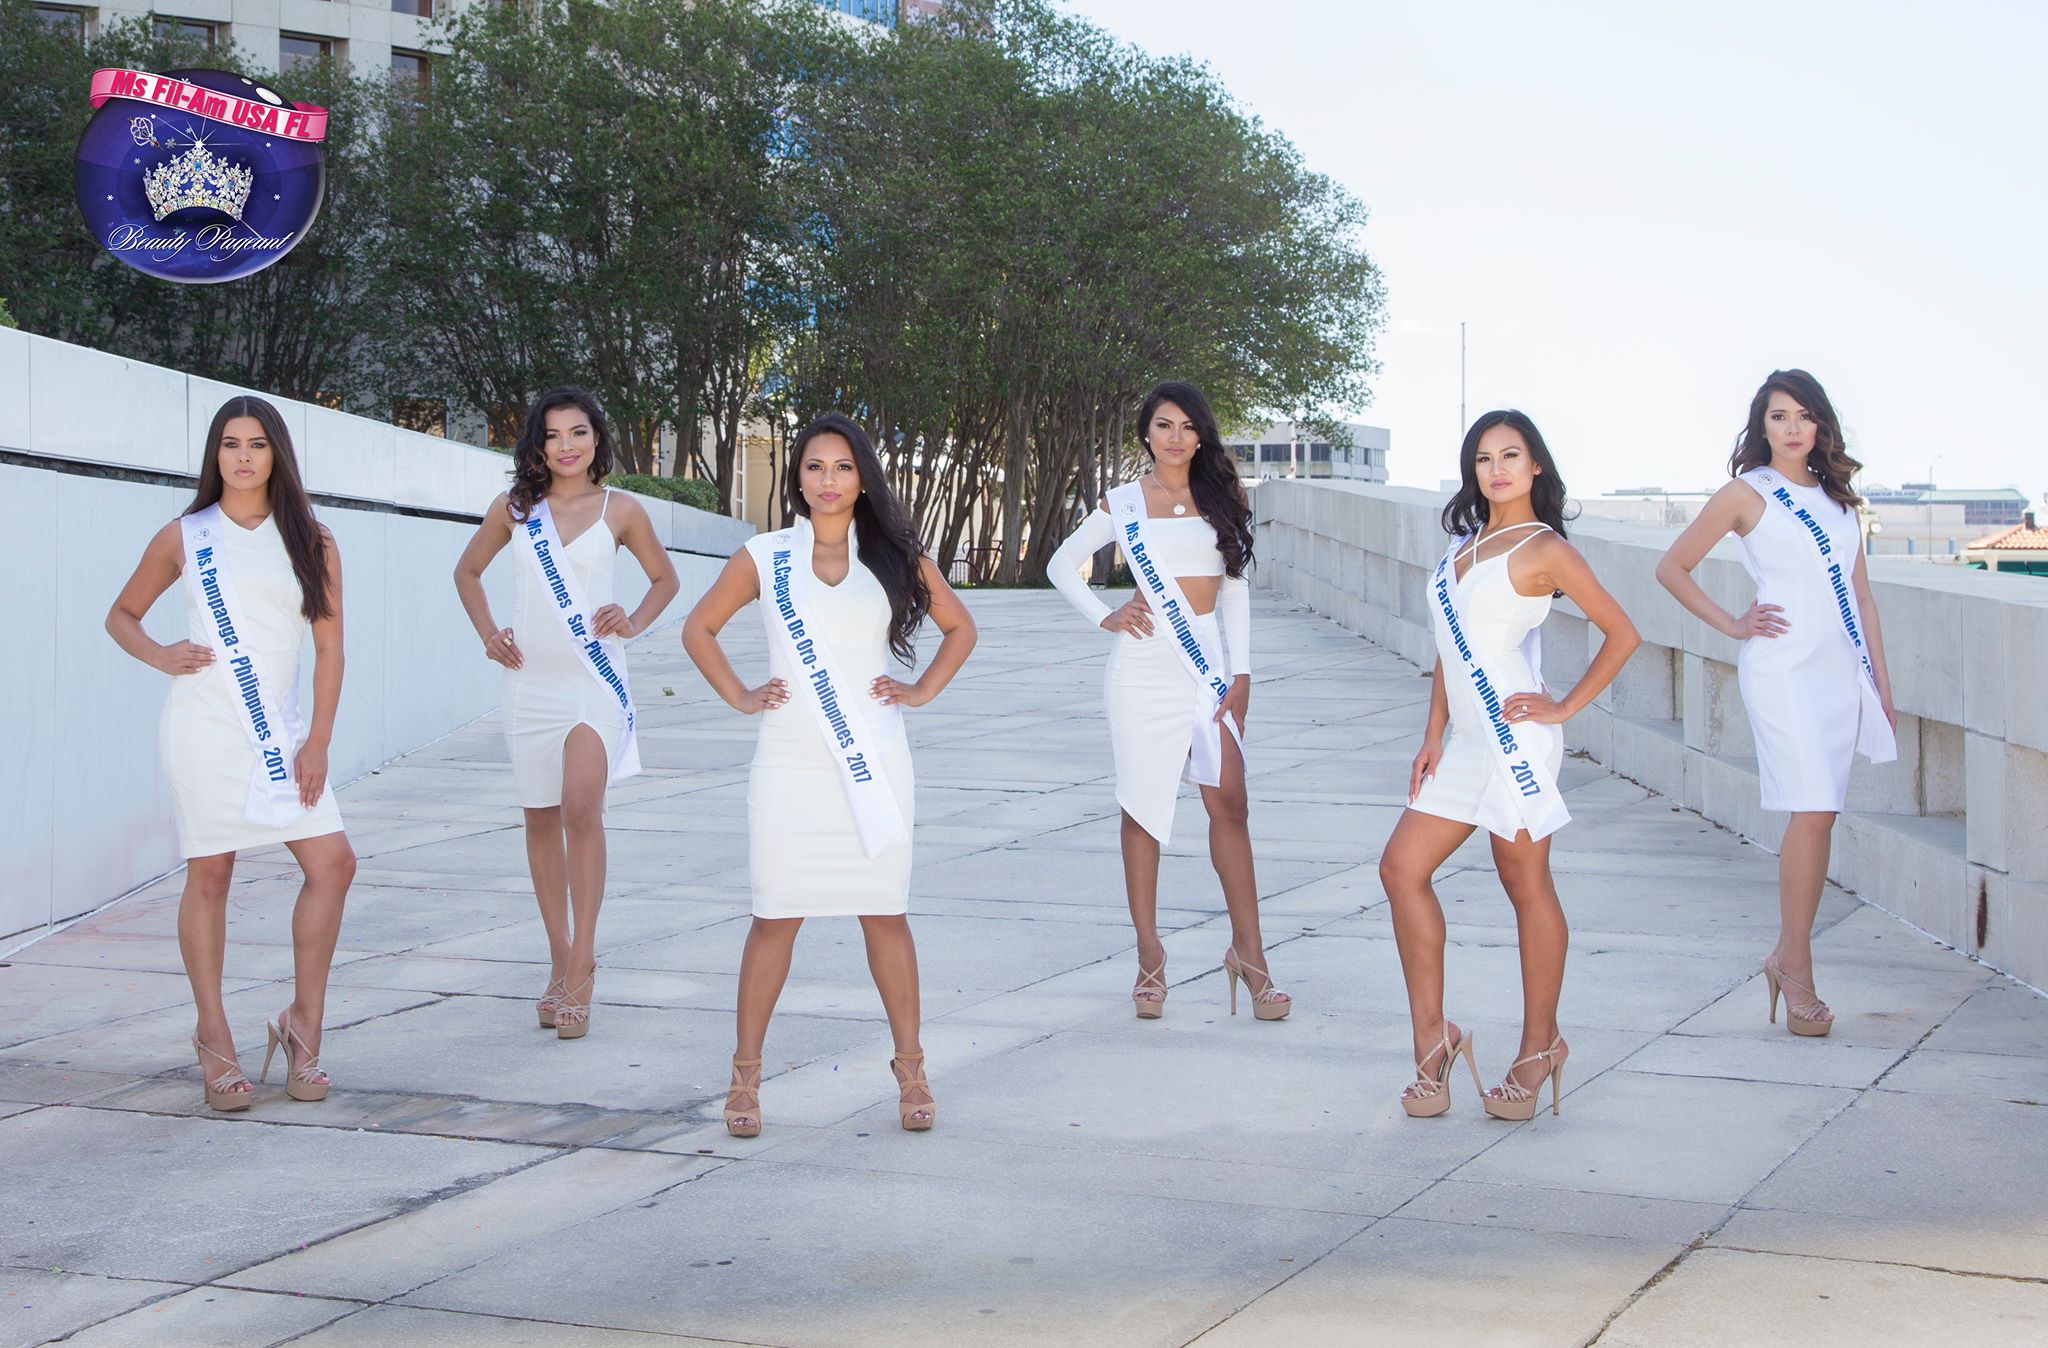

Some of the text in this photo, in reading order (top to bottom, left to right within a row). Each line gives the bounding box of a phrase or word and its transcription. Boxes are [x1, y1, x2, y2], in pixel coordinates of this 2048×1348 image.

[524, 516, 543, 540] Ms.
[1124, 520, 1140, 546] Ms.
[1772, 485, 1793, 511] Ms.
[1793, 507, 1832, 557] Manila
[533, 539, 573, 609] Camarines
[1131, 541, 1165, 594] Bataan
[567, 613, 588, 638] Sur
[1161, 598, 1210, 676] Philippines
[199, 566, 239, 648] Pampanga
[229, 655, 272, 742] Philippines
[263, 746, 288, 782] 2017
[584, 639, 629, 710] Philippines
[786, 618, 806, 640] De
[809, 668, 855, 750] Philippines
[846, 752, 873, 784] 2017
[1435, 577, 1473, 662] Parañaque
[1510, 760, 1542, 797] 2017
